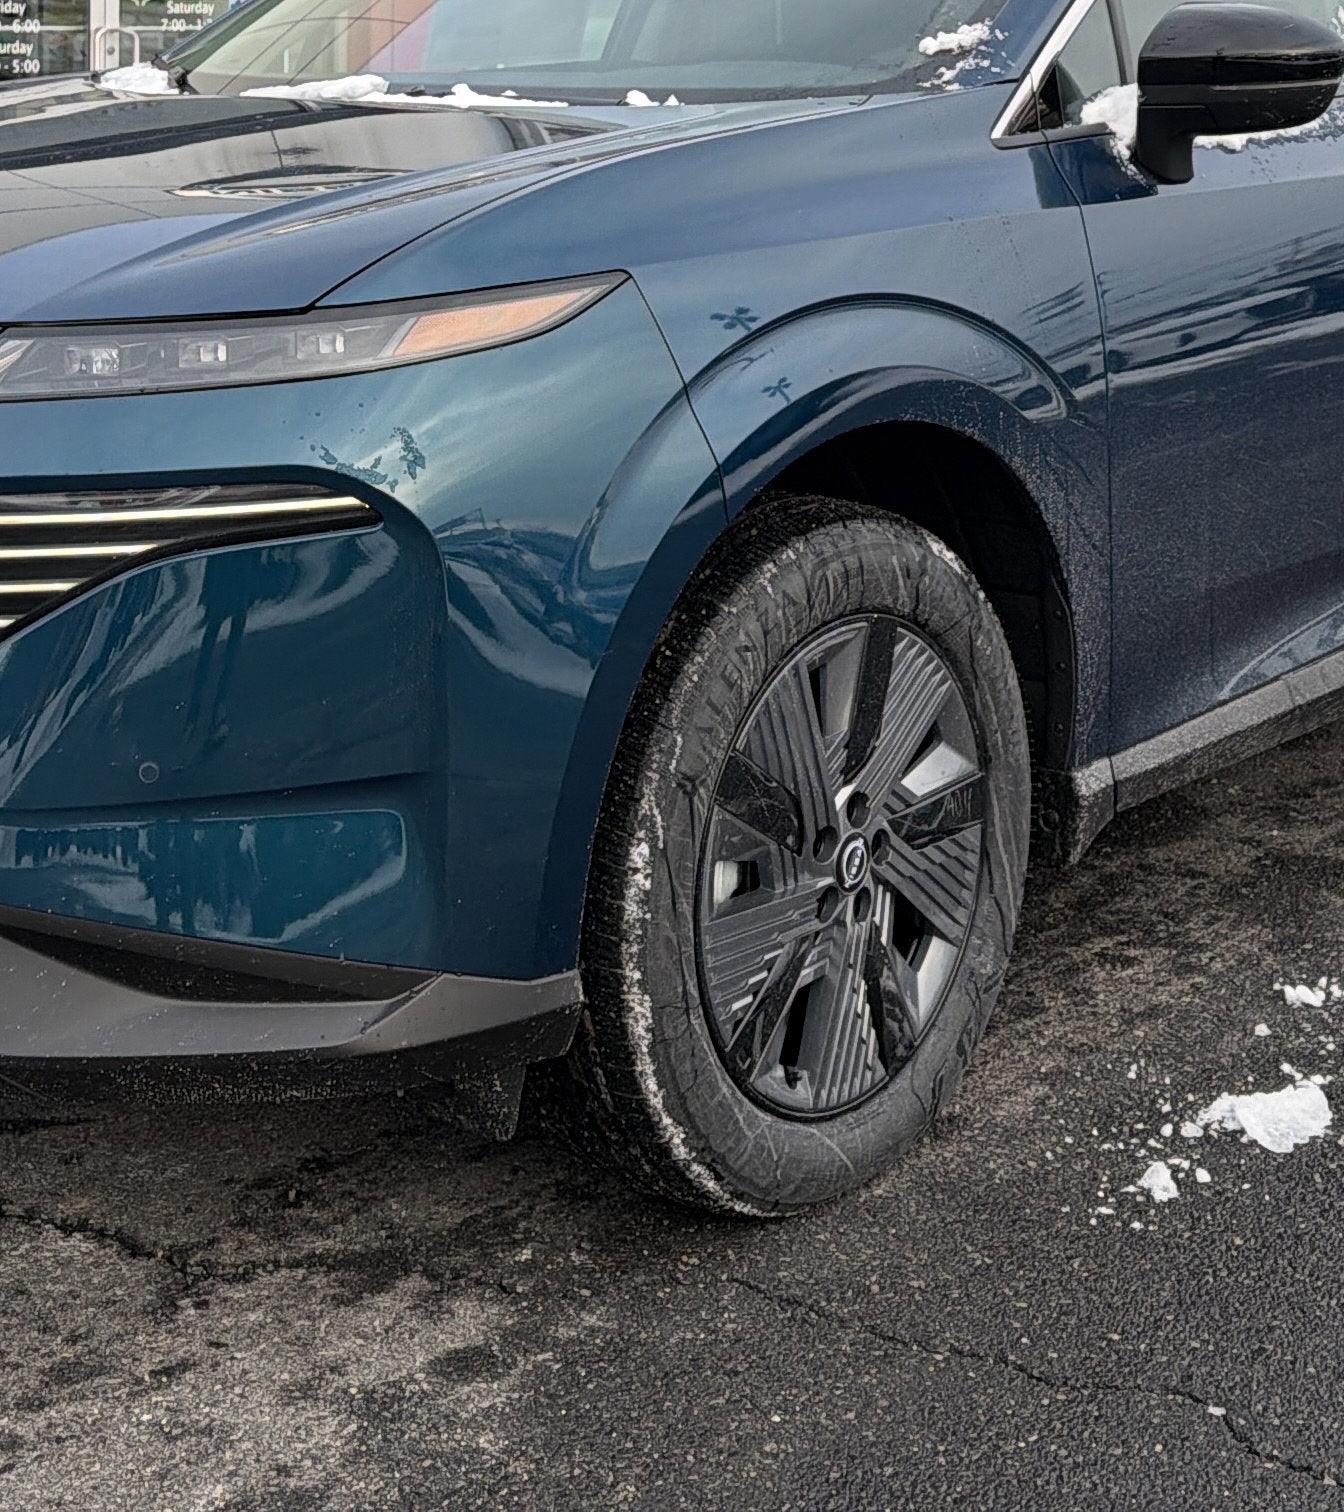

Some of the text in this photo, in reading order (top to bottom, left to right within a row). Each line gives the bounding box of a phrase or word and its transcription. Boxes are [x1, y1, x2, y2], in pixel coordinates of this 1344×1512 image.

[167, 1, 215, 15] Saturday
[12, 19, 40, 33] 6:00
[161, 18, 186, 32] 7:00
[12, 60, 40, 74] 5:00
